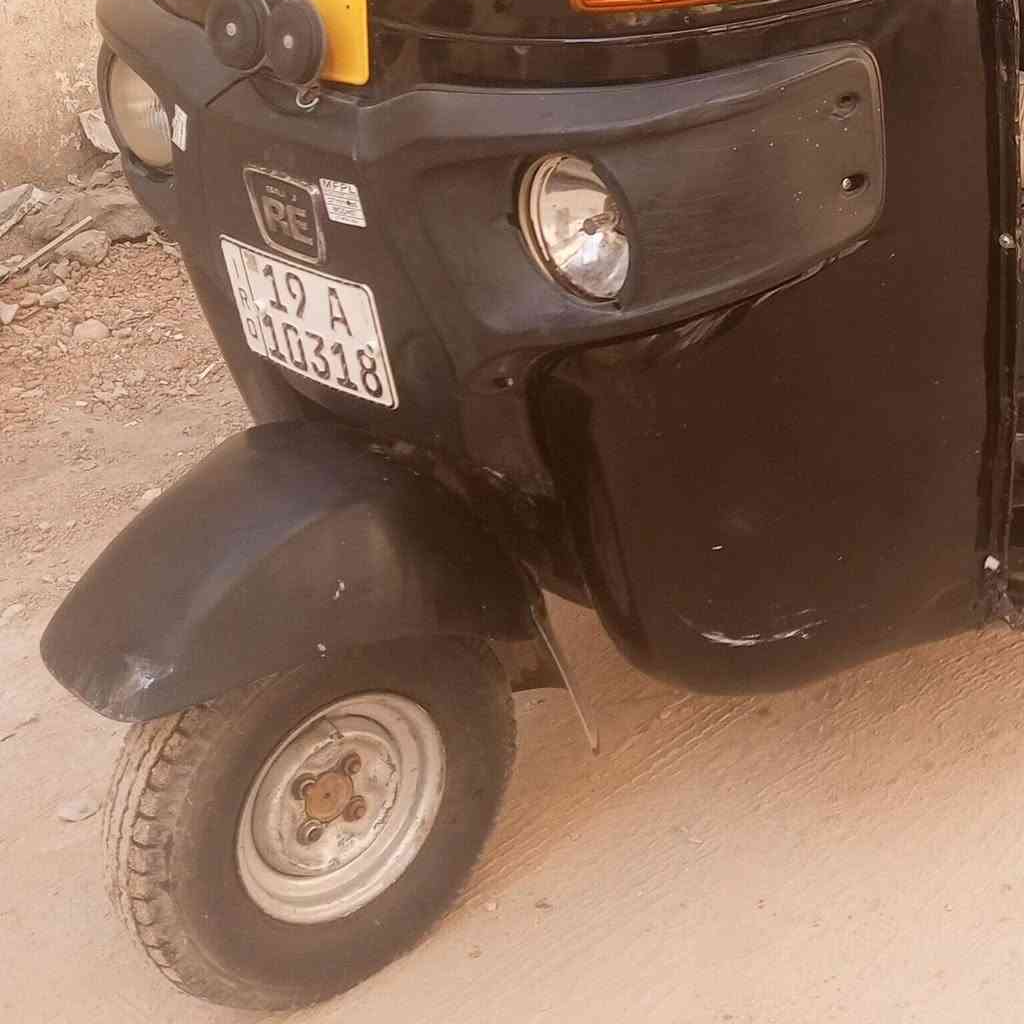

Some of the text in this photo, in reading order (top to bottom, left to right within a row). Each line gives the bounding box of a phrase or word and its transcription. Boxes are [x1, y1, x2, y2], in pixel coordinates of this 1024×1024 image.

[262, 195, 313, 246] RE
[263, 264, 352, 337] 19 A
[263, 314, 383, 398] 10318
